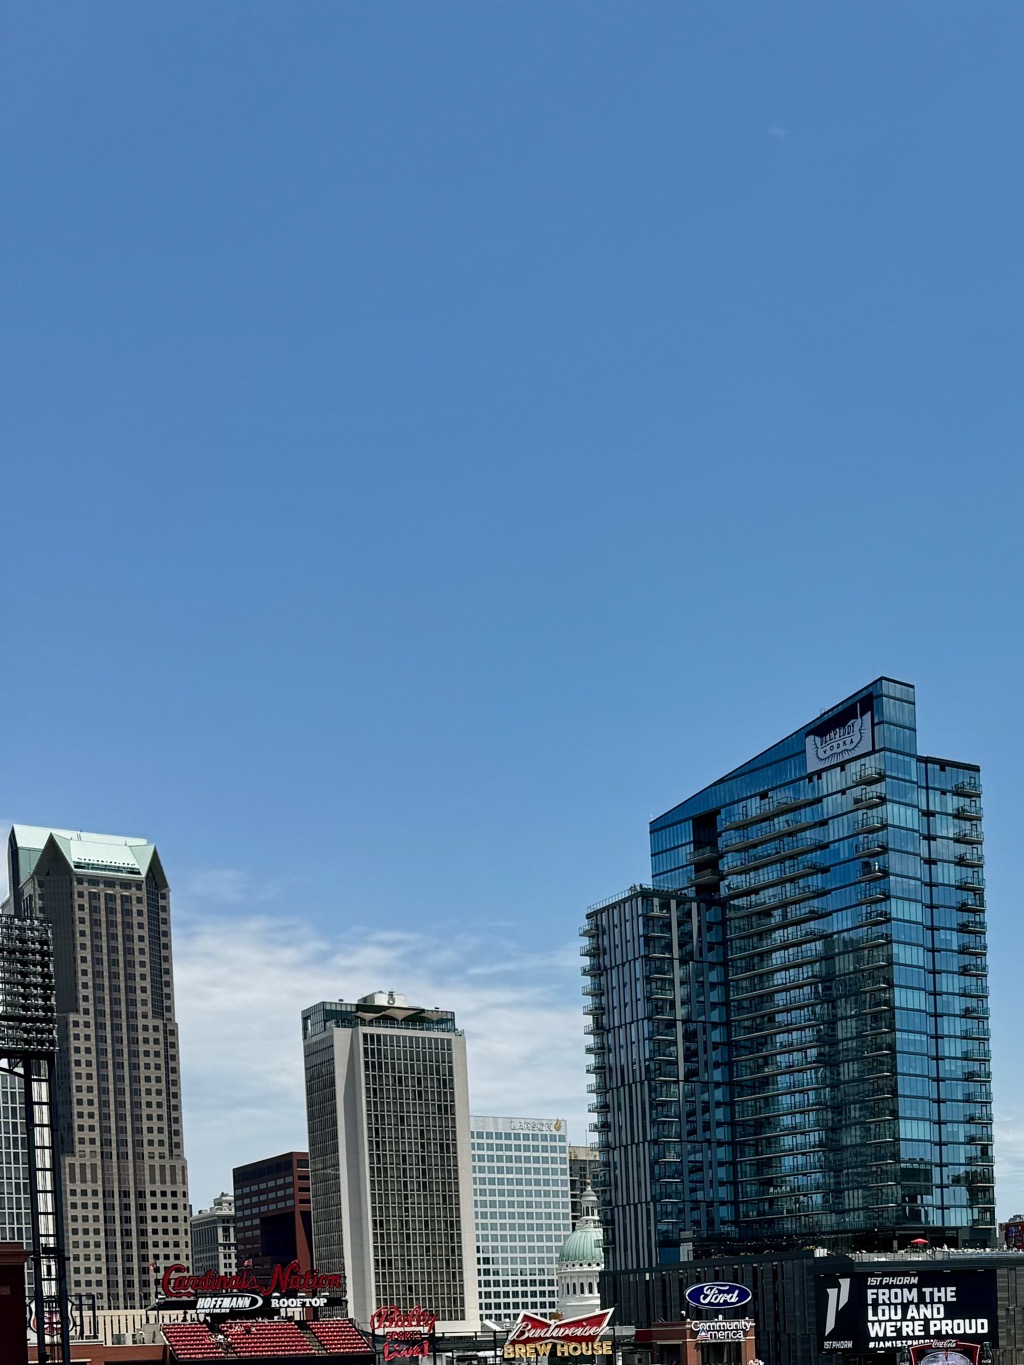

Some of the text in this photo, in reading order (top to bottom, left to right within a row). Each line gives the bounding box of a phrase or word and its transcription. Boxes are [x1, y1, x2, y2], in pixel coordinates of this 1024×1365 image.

[823, 738, 854, 755] VODKA
[162, 1259, 342, 1297] Cardinals Nation
[883, 1276, 919, 1285] PHORM
[196, 1297, 251, 1309] HOFFMANN
[271, 1297, 328, 1308] ROOFTOP
[700, 1285, 739, 1304] Ford
[867, 1287, 957, 1305] FROM THE
[867, 1303, 945, 1321] LOU AND
[510, 1321, 609, 1340] Budweiser
[691, 1320, 751, 1332] Community
[867, 1318, 989, 1338] WE'RE PROUD
[503, 1340, 613, 1359] BREW HOUSE
